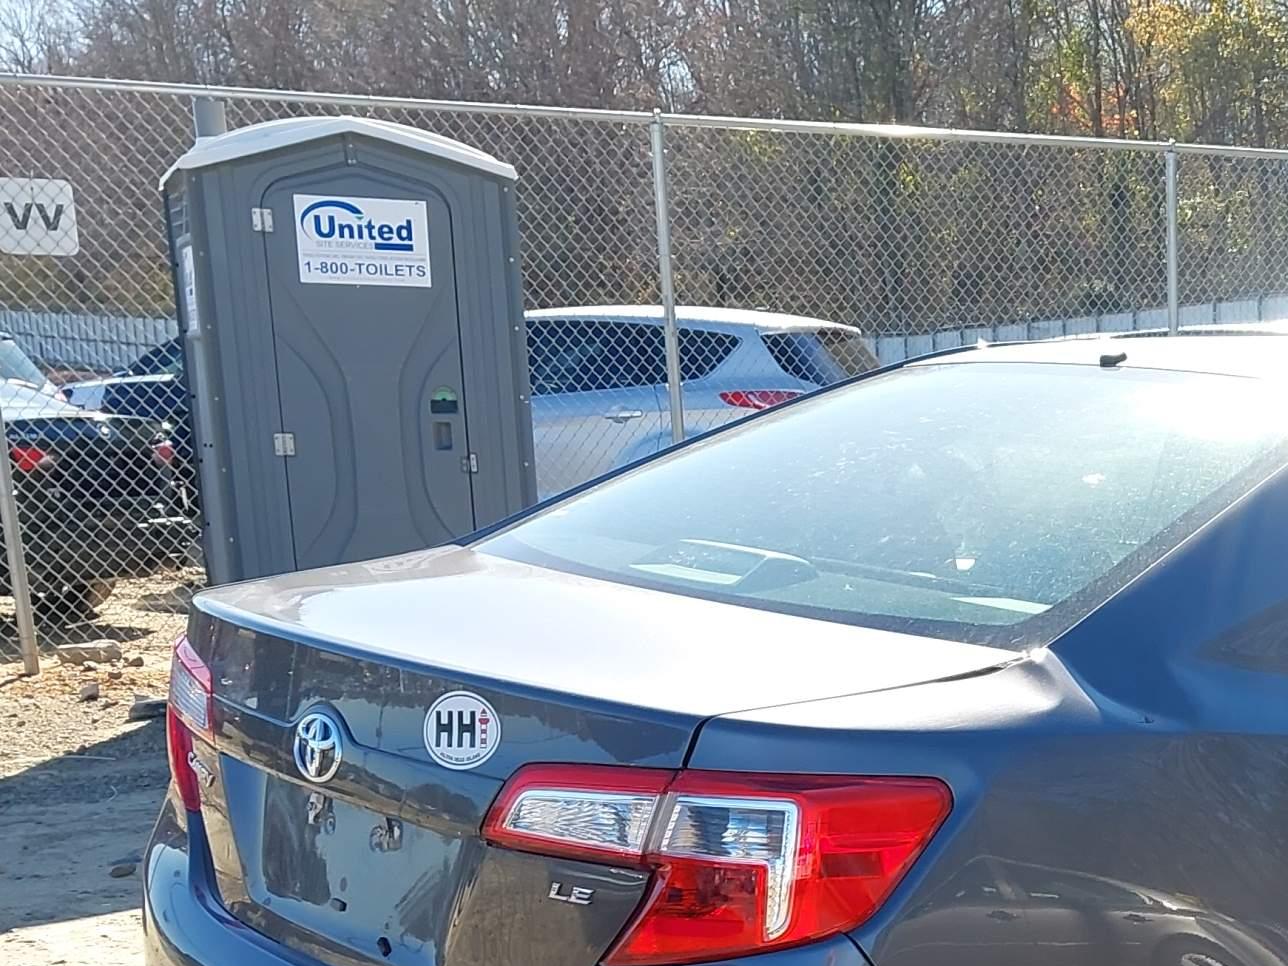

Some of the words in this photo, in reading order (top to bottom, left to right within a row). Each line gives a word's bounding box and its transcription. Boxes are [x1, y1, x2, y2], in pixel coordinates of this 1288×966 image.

[313, 214, 414, 242] United
[315, 240, 333, 249] SITE
[335, 241, 374, 250] SERVICES
[304, 260, 427, 278] 1-800-TOILETS
[547, 881, 595, 905] LE
